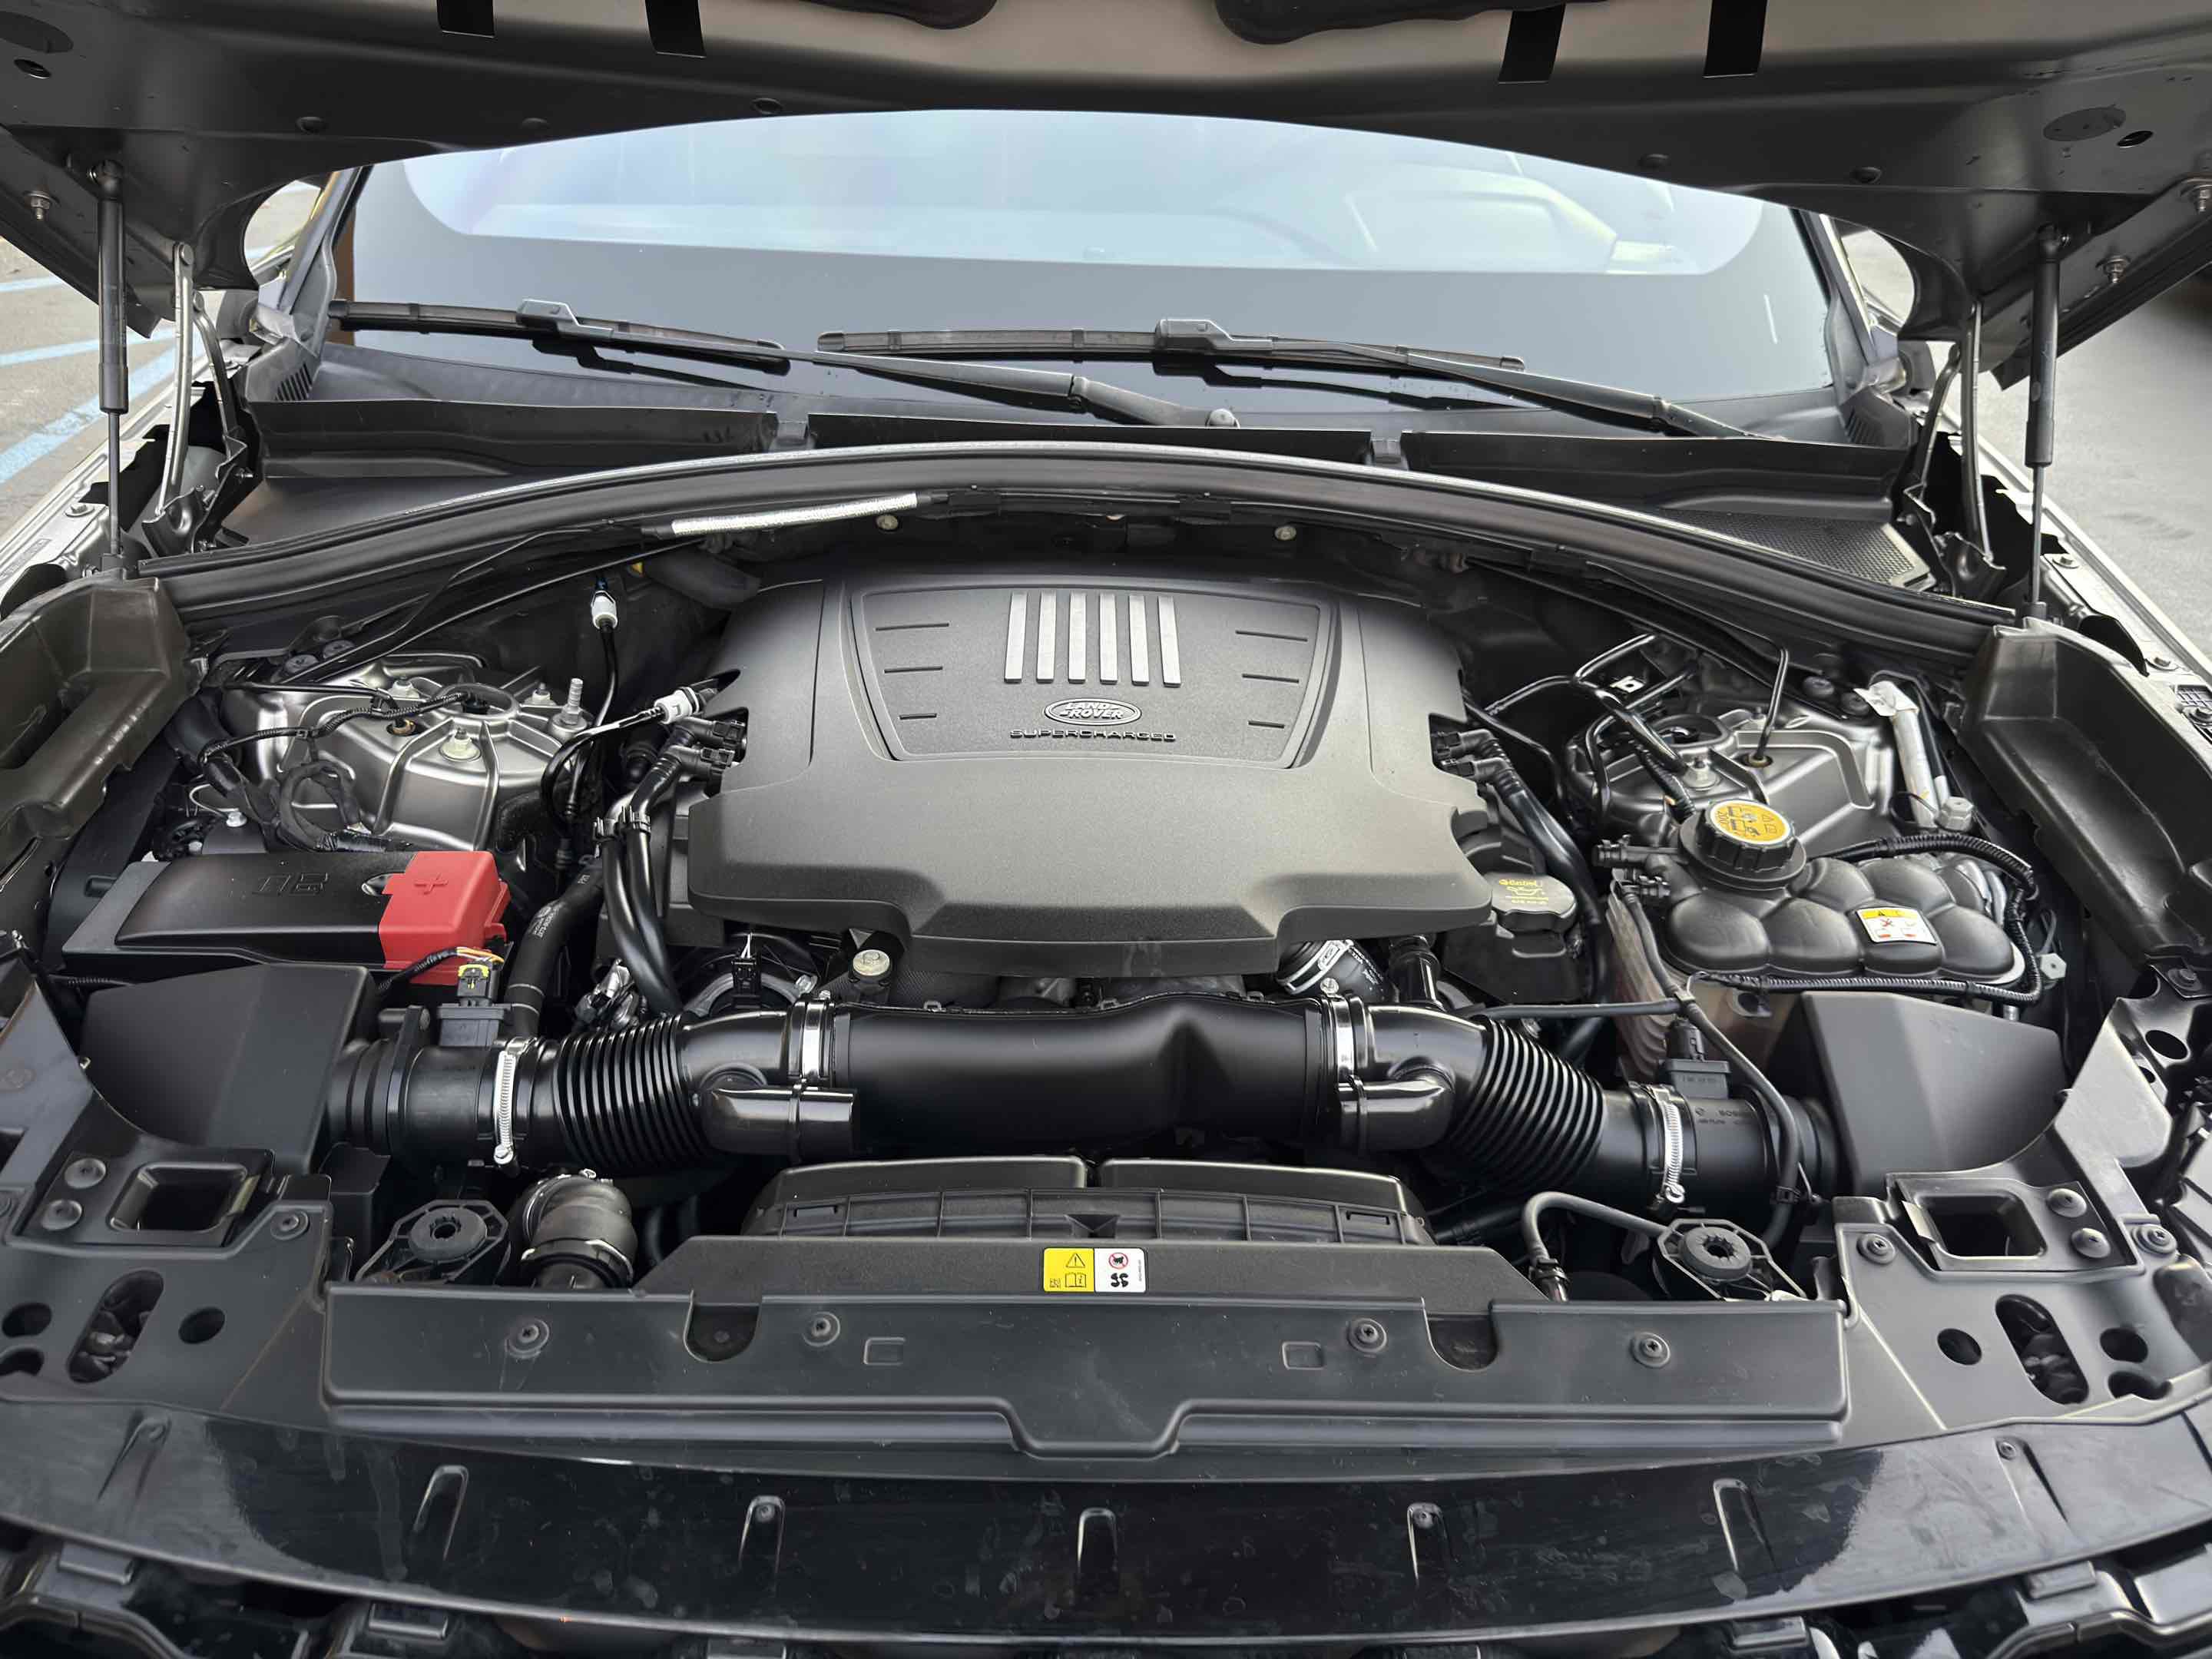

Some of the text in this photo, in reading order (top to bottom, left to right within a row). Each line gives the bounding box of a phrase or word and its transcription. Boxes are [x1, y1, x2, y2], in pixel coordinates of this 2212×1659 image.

[1065, 701, 1109, 710] LAND
[1068, 708, 1124, 719] ROVER
[1010, 729, 1176, 742] SUPERCHARGED
